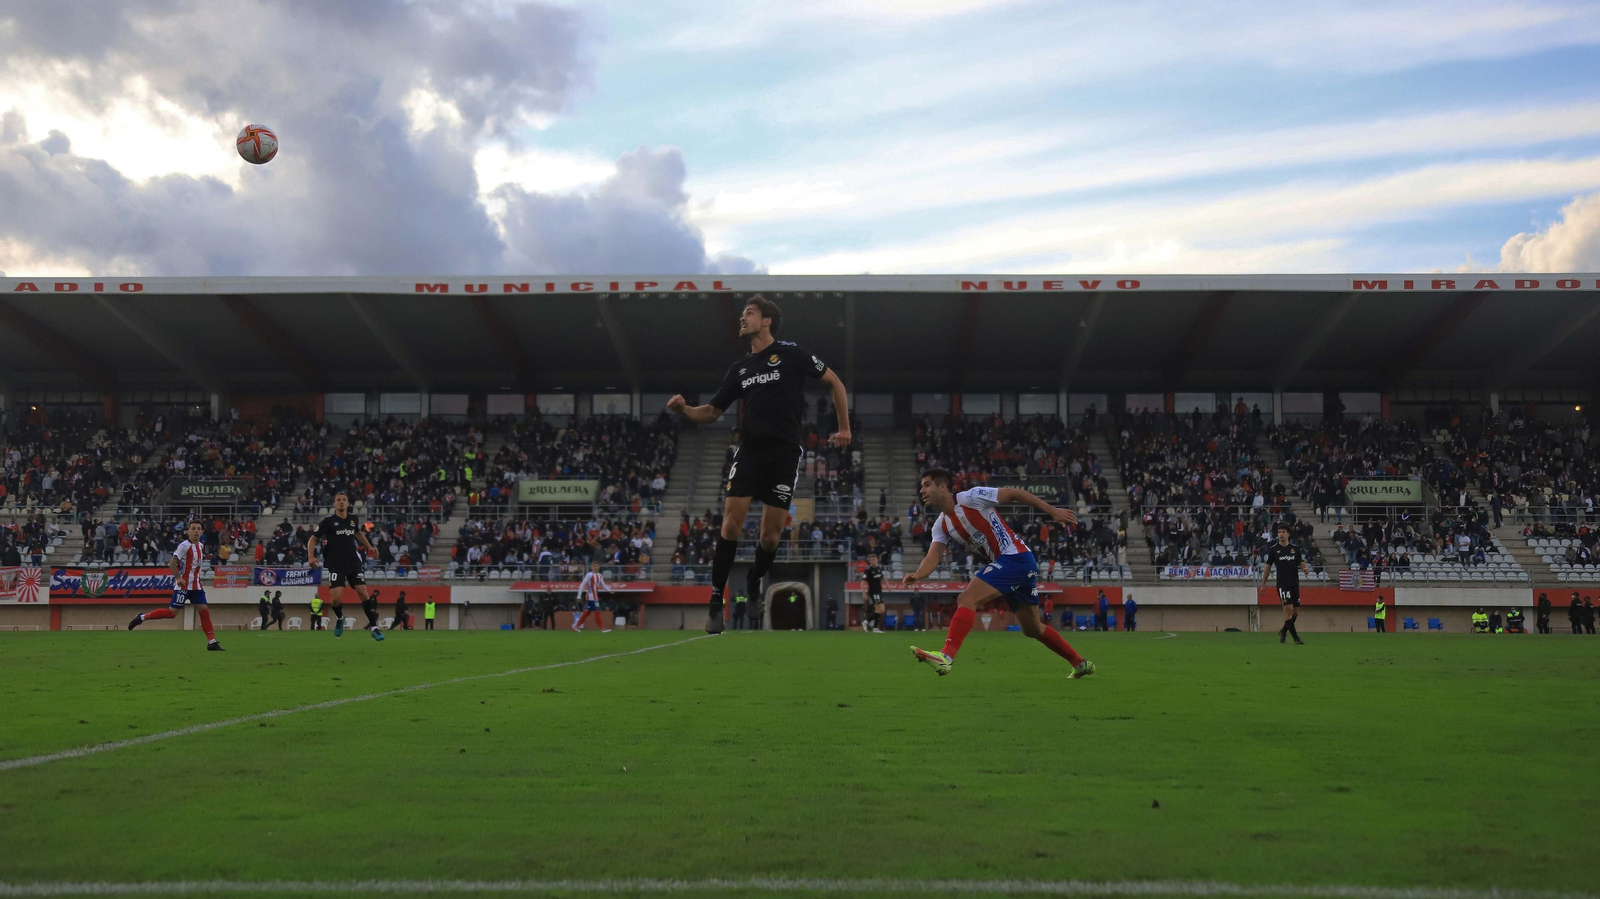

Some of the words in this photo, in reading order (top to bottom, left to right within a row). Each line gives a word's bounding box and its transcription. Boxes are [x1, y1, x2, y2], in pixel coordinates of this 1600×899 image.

[415, 281, 722, 293] MUNICIPAL
[961, 281, 1140, 291] NUEVO
[1353, 280, 1600, 290] MIRADO
[728, 461, 738, 480] 6
[286, 570, 310, 578] FRENTE
[1196, 568, 1204, 577] EL
[1209, 568, 1249, 577] TACONAZO
[51, 569, 82, 597] Soy
[176, 594, 185, 604] 10
[1282, 590, 1292, 599] 14
